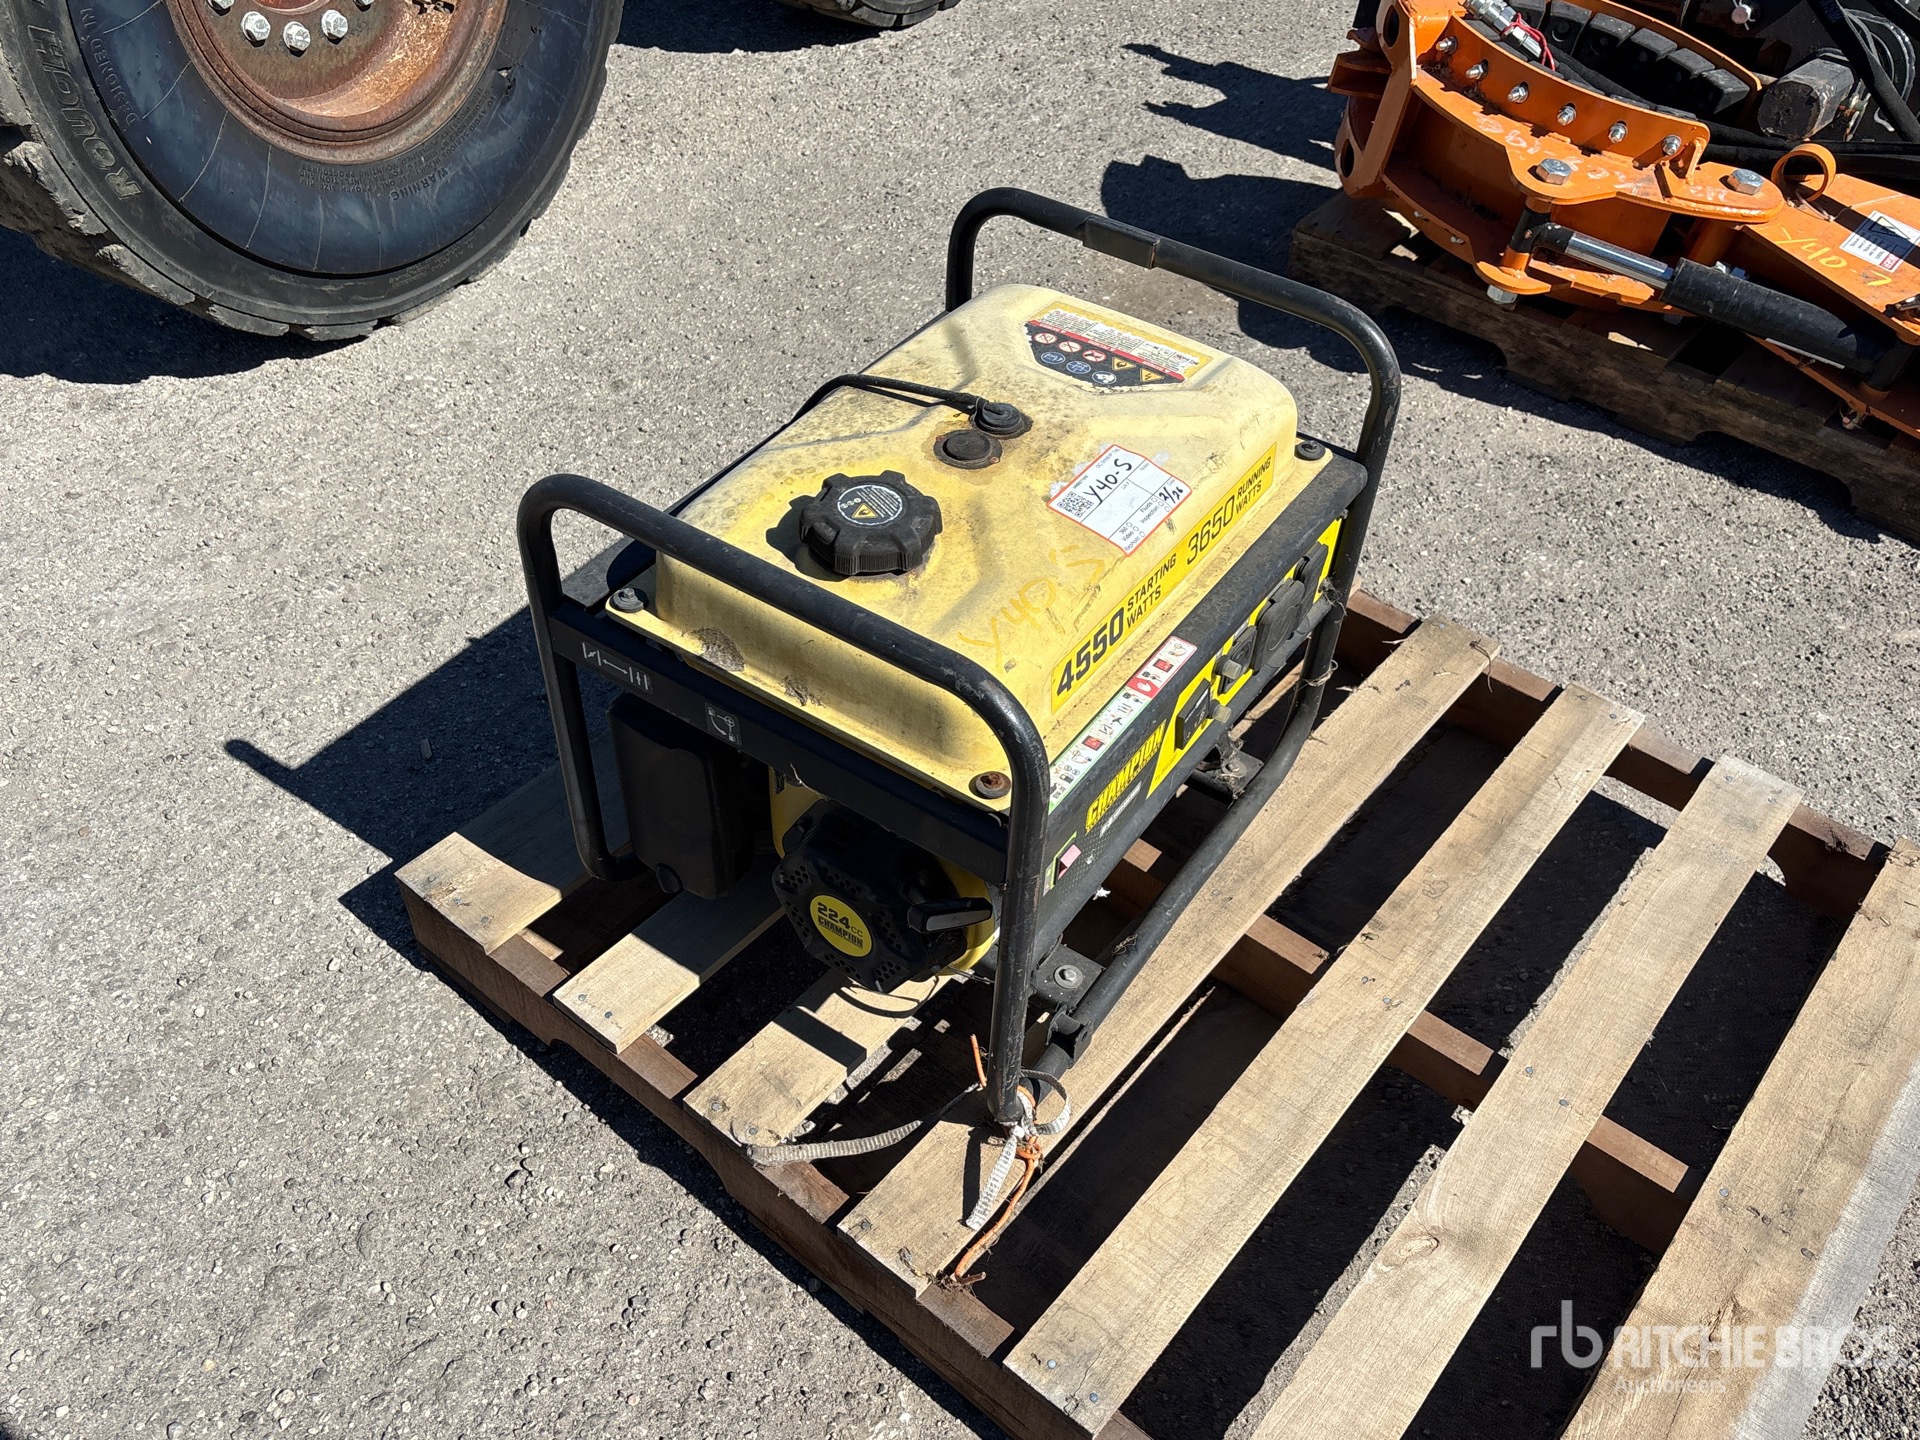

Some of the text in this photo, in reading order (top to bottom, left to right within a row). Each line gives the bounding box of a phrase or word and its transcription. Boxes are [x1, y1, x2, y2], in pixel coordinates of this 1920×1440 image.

[80, 7, 140, 126] DESIGNED IN
[468, 108, 488, 132] AVOID
[440, 131, 470, 159] SERIOUS
[340, 183, 372, 193] PROPER
[391, 168, 448, 200] WARNING
[1236, 457, 1272, 499] RUNNING
[1236, 481, 1262, 514] WATTS
[1140, 506, 1160, 524] Inspection
[1187, 494, 1234, 565] 3650
[1122, 530, 1134, 542] Video
[1127, 553, 1177, 612] STARTING
[1126, 585, 1162, 628] WATTS
[1056, 607, 1124, 696] 4550
[1085, 719, 1166, 834] CHAMPION
[818, 915, 864, 948] CHAMPION
